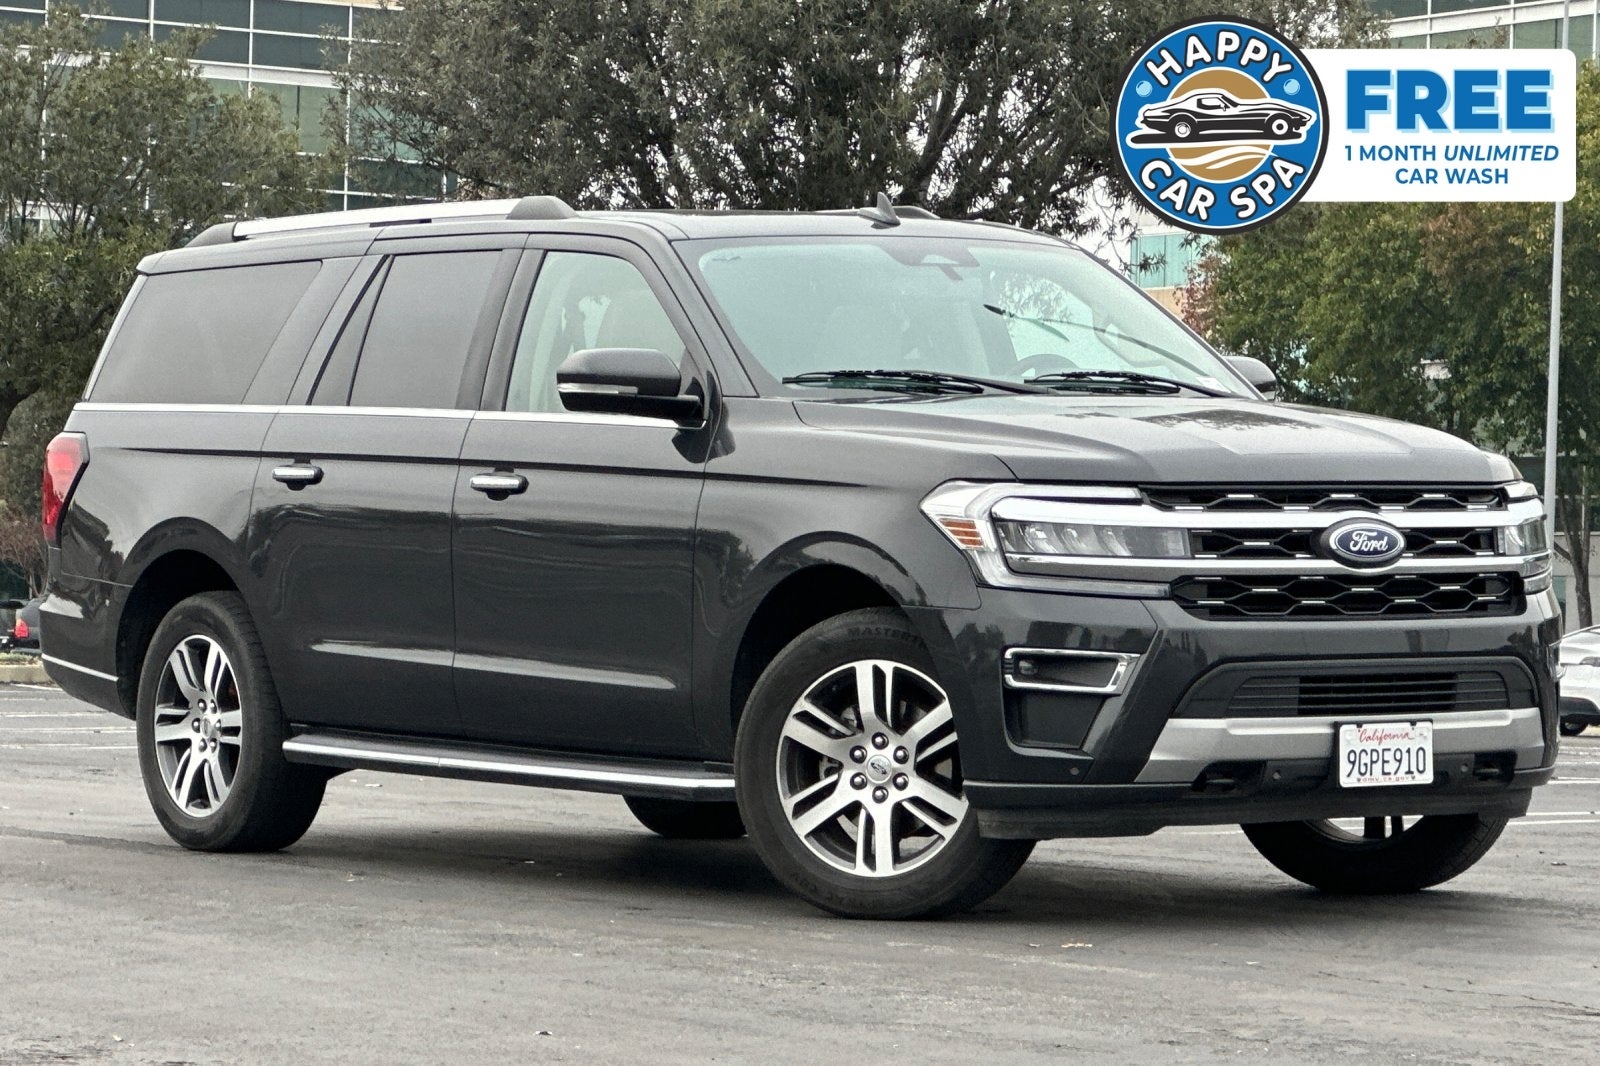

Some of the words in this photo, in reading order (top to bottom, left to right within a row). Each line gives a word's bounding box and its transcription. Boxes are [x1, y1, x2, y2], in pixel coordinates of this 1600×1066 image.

[1349, 530, 1389, 551] Ford
[1359, 728, 1415, 745] California
[1346, 746, 1427, 778] 9GPE910
